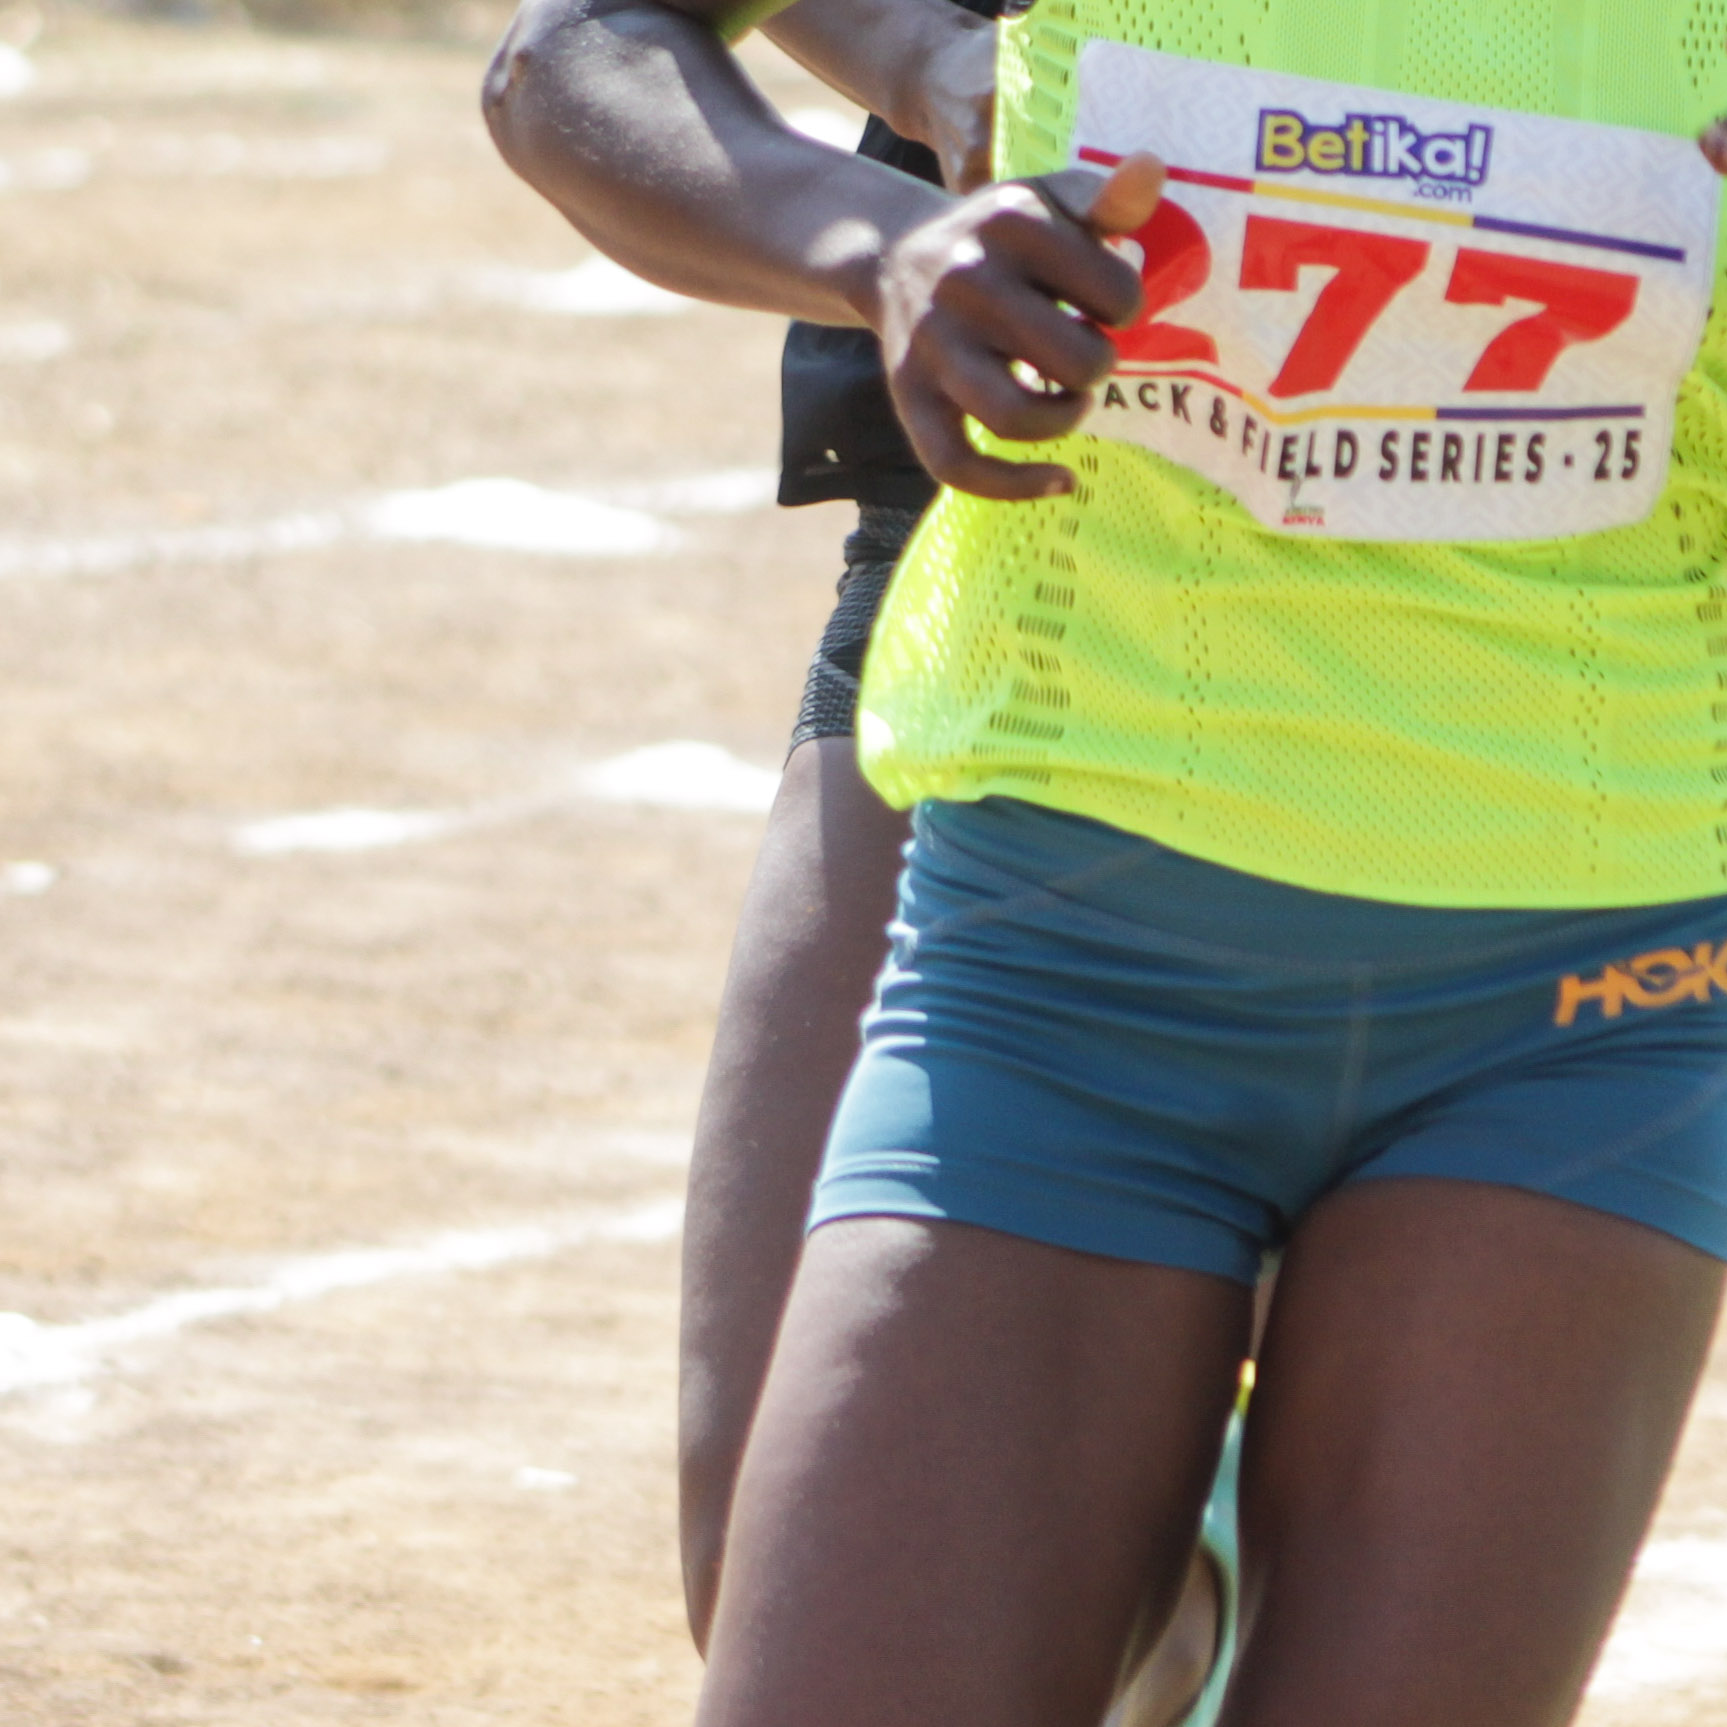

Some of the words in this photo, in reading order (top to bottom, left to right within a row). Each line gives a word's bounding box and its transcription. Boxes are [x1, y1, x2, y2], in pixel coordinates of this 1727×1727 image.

[1257, 109, 1493, 186] Betika!
[1414, 182, 1473, 203] .com
[1100, 196, 1641, 399] 277
[1209, 396, 1227, 440] &
[1241, 415, 1360, 481] FIELD
[1378, 429, 1547, 484] SERIES
[1593, 428, 1643, 482] 25
